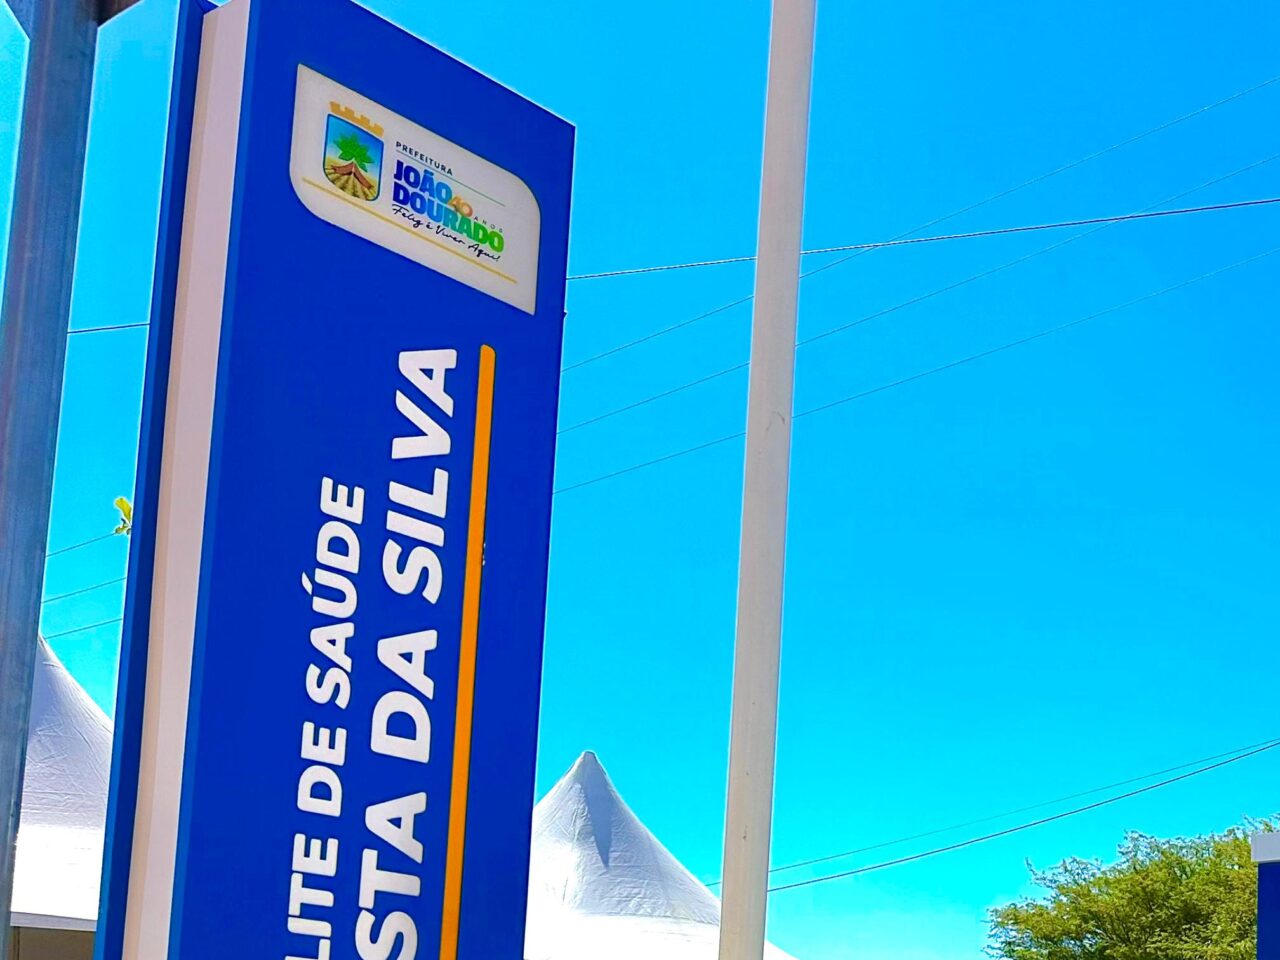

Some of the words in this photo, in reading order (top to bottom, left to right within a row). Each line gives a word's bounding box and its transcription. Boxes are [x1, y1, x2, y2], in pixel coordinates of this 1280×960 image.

[394, 160, 452, 204] JOÃO
[396, 141, 453, 176] PREFEITURA
[393, 181, 504, 253] DOURADO
[382, 348, 457, 605] SILVA
[302, 476, 365, 709] SAÚDE
[371, 629, 438, 763] DA
[297, 721, 347, 817] DE
